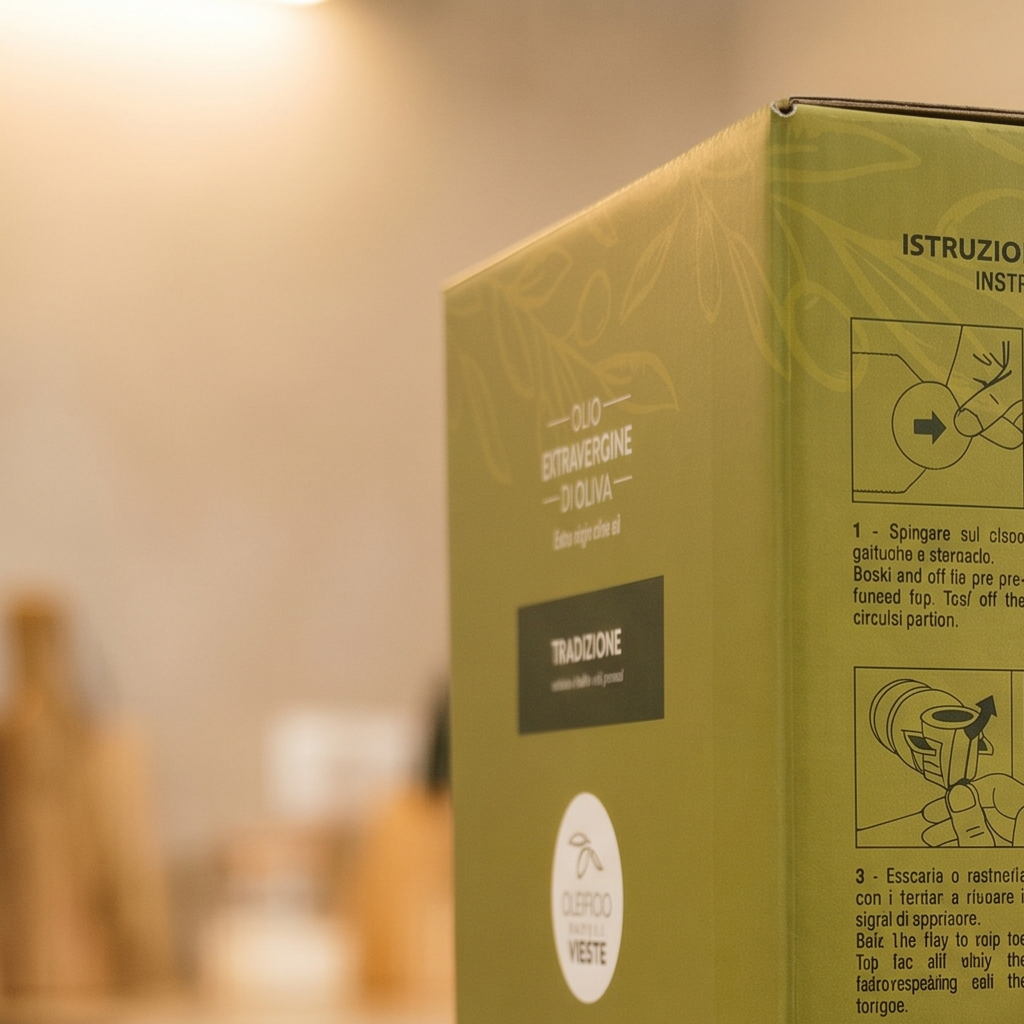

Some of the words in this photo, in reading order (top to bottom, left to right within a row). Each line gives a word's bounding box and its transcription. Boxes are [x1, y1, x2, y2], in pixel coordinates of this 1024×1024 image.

[572, 397, 601, 432] OLIO
[542, 424, 632, 482] EXTRAVERGINE
[561, 484, 573, 513] DI
[575, 473, 612, 509] OLIVA
[853, 522, 860, 537] 1
[890, 523, 950, 544] Spingare
[961, 527, 979, 542] sul
[854, 566, 891, 582] Boski
[897, 568, 922, 583] and
[928, 569, 946, 584] off
[972, 573, 993, 589] pre
[980, 591, 997, 607] off
[907, 611, 958, 629] partion.
[551, 628, 621, 666] TRADIZIONE
[856, 868, 865, 884] 3
[887, 868, 943, 883] Esscaria
[952, 871, 959, 883] o
[856, 893, 881, 905] con
[889, 890, 892, 904] i
[952, 892, 959, 904] a
[896, 911, 909, 926] di
[956, 932, 968, 947] to
[569, 940, 607, 965] VIESTE
[893, 954, 913, 970] fac
